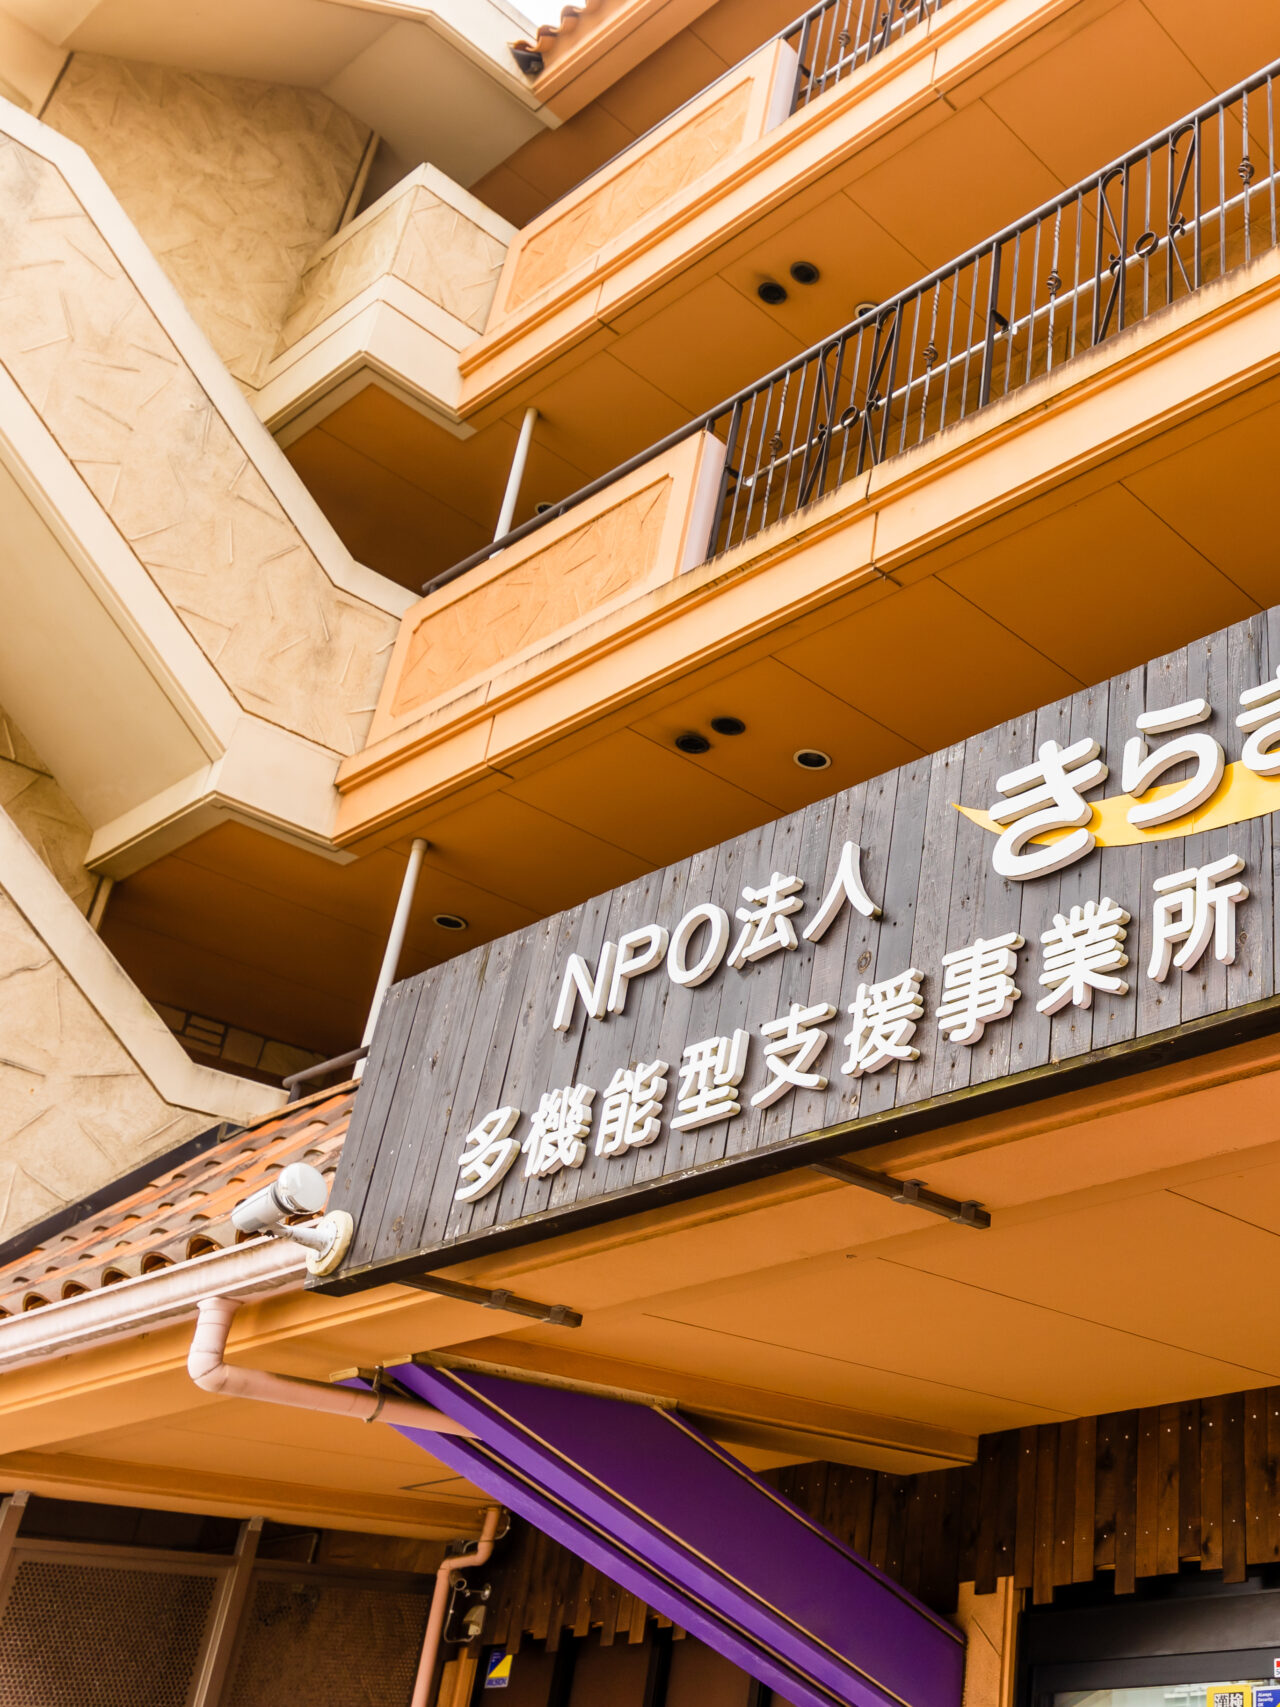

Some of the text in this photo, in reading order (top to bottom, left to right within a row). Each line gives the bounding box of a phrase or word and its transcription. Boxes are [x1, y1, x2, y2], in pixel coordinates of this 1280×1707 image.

[454, 854, 1250, 1203] 多機能型支援事業所
[553, 840, 882, 1032] NPO法人
